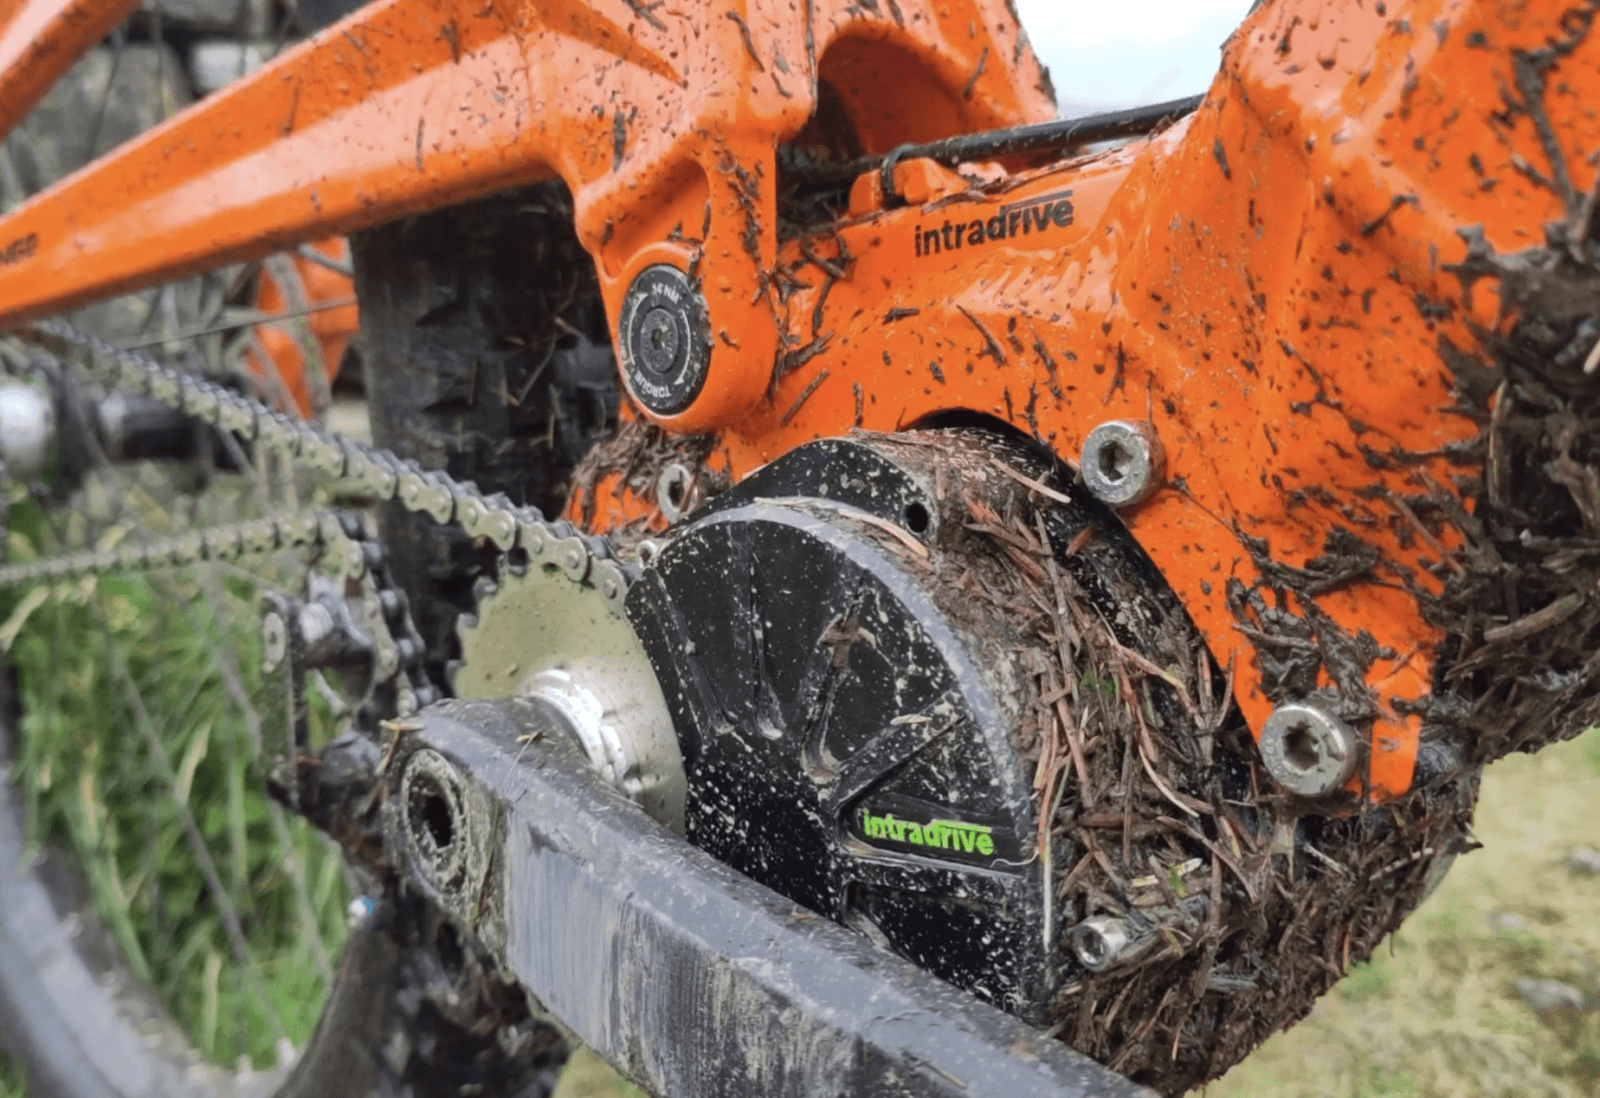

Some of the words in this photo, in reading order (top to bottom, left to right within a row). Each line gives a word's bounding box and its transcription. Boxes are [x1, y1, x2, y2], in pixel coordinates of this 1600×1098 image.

[915, 189, 1074, 257] intradrive
[634, 369, 672, 398] TORQUE
[863, 807, 995, 855] intradrive
